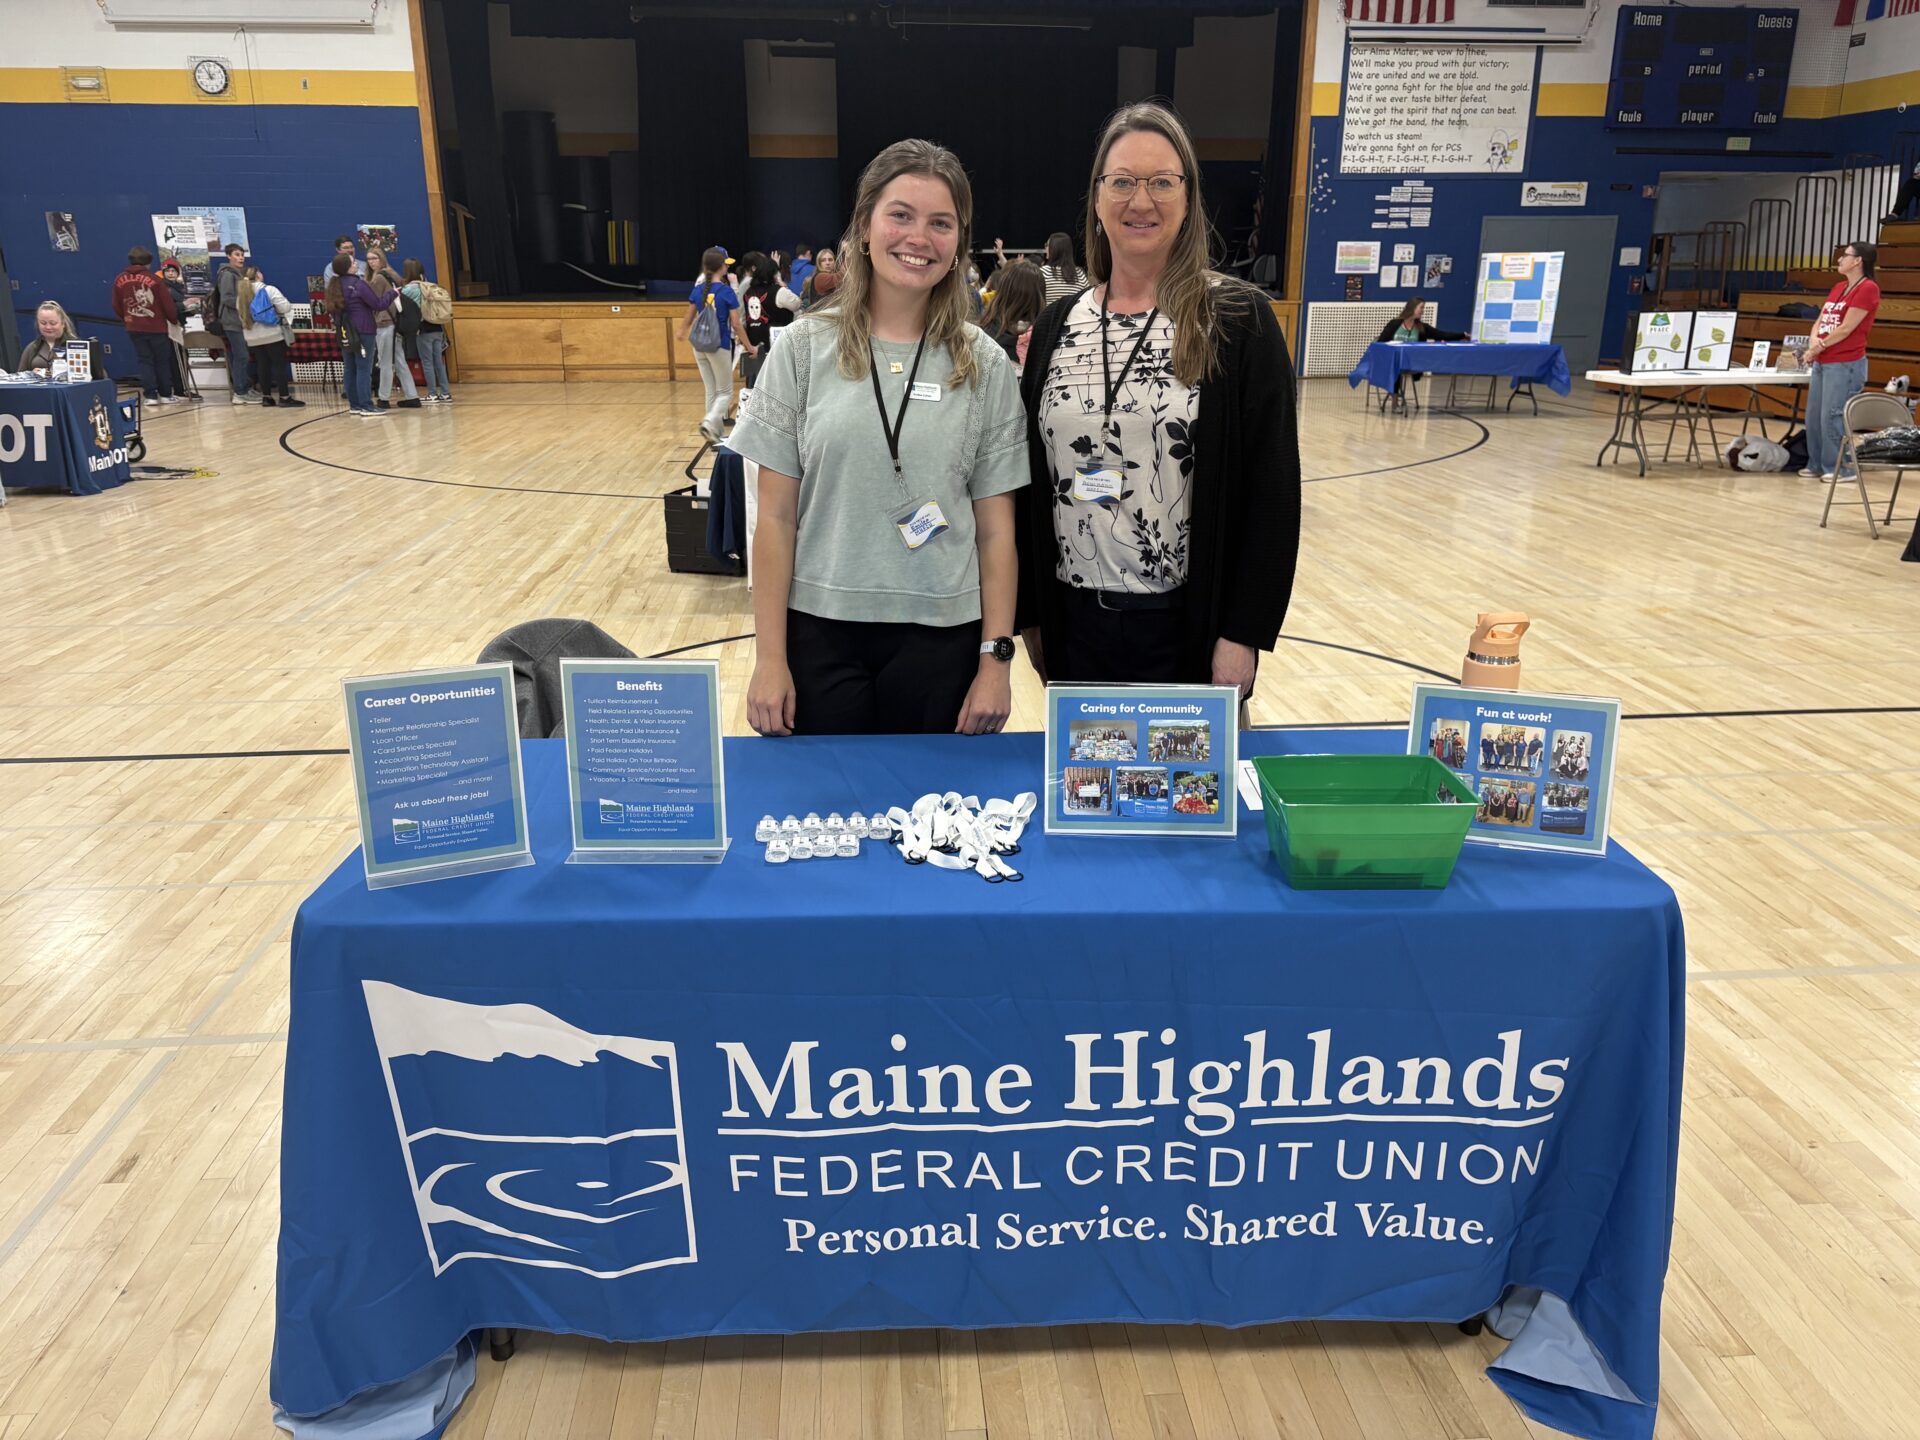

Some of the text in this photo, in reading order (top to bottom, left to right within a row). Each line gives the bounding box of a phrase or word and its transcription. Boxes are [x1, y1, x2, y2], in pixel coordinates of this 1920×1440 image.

[1633, 11, 1663, 26] Home
[1757, 14, 1793, 29] Guests
[1351, 47, 1368, 55] Our
[1369, 47, 1390, 55] Alma
[1393, 47, 1420, 57] Mater,
[1468, 48, 1488, 56] thee,
[1351, 59, 1371, 67] We'll
[1374, 59, 1395, 67] make
[1398, 61, 1413, 69] you
[1415, 59, 1439, 70] proud
[1688, 63, 1722, 77] period
[1350, 71, 1363, 79] We
[1383, 71, 1408, 79] united
[1411, 71, 1426, 79] and
[1459, 71, 1479, 79] bold.
[1348, 83, 1530, 93] We're gonna fight for the blue and the gold.
[1347, 94, 1363, 102] And
[1366, 94, 1373, 102] if
[1347, 106, 1371, 114] We've
[1373, 106, 1387, 116] got
[1390, 106, 1404, 114] the
[1407, 106, 1428, 117] spirit
[1431, 106, 1448, 114] that
[1497, 106, 1516, 114] beat.
[1681, 110, 1715, 124] player
[1346, 117, 1370, 126] We've
[1372, 118, 1386, 128] got
[1389, 117, 1403, 125] the
[1406, 118, 1427, 126] band,
[1448, 118, 1469, 126] team,
[1345, 132, 1355, 140] So
[1357, 132, 1382, 140] watch
[1396, 132, 1422, 140] steam!
[1344, 143, 1367, 151] We're
[1369, 145, 1393, 154] gonna
[1396, 142, 1415, 154] fight
[1431, 143, 1443, 151] for
[1446, 143, 1462, 151] PCS
[1343, 155, 1473, 164] F-I-G-H-T, F-I-G-H-T, F-I-G-H-T
[616, 680, 663, 691] Benefits
[364, 686, 496, 709] Career Opportunities
[627, 708, 694, 716] Learning Opportunities
[1080, 703, 1203, 715] Caring for Community
[1476, 706, 1552, 723] Fun at work!
[373, 716, 392, 724] Teller
[374, 717, 480, 734] Member Relationship Specialist
[395, 734, 418, 743] Officer
[377, 740, 457, 755] Card Services Specialist
[629, 747, 653, 755] Holidays
[379, 750, 452, 766] Accounting Specialist
[379, 756, 489, 775] Information Technology Assistant
[381, 771, 448, 786] Marketing Specialist
[473, 775, 493, 784] more!
[394, 802, 409, 810] Ask
[421, 797, 445, 806] about
[447, 794, 468, 802] these
[470, 790, 489, 801] jobs!
[625, 804, 694, 814] Maine Highlands
[422, 810, 495, 828] Maine Highlands
[715, 1027, 1570, 1137] Maine Highlands
[729, 1139, 1545, 1198] FEDERAL CREDIT UNION
[782, 1201, 1495, 1256] Personal Service. Shared Value.
